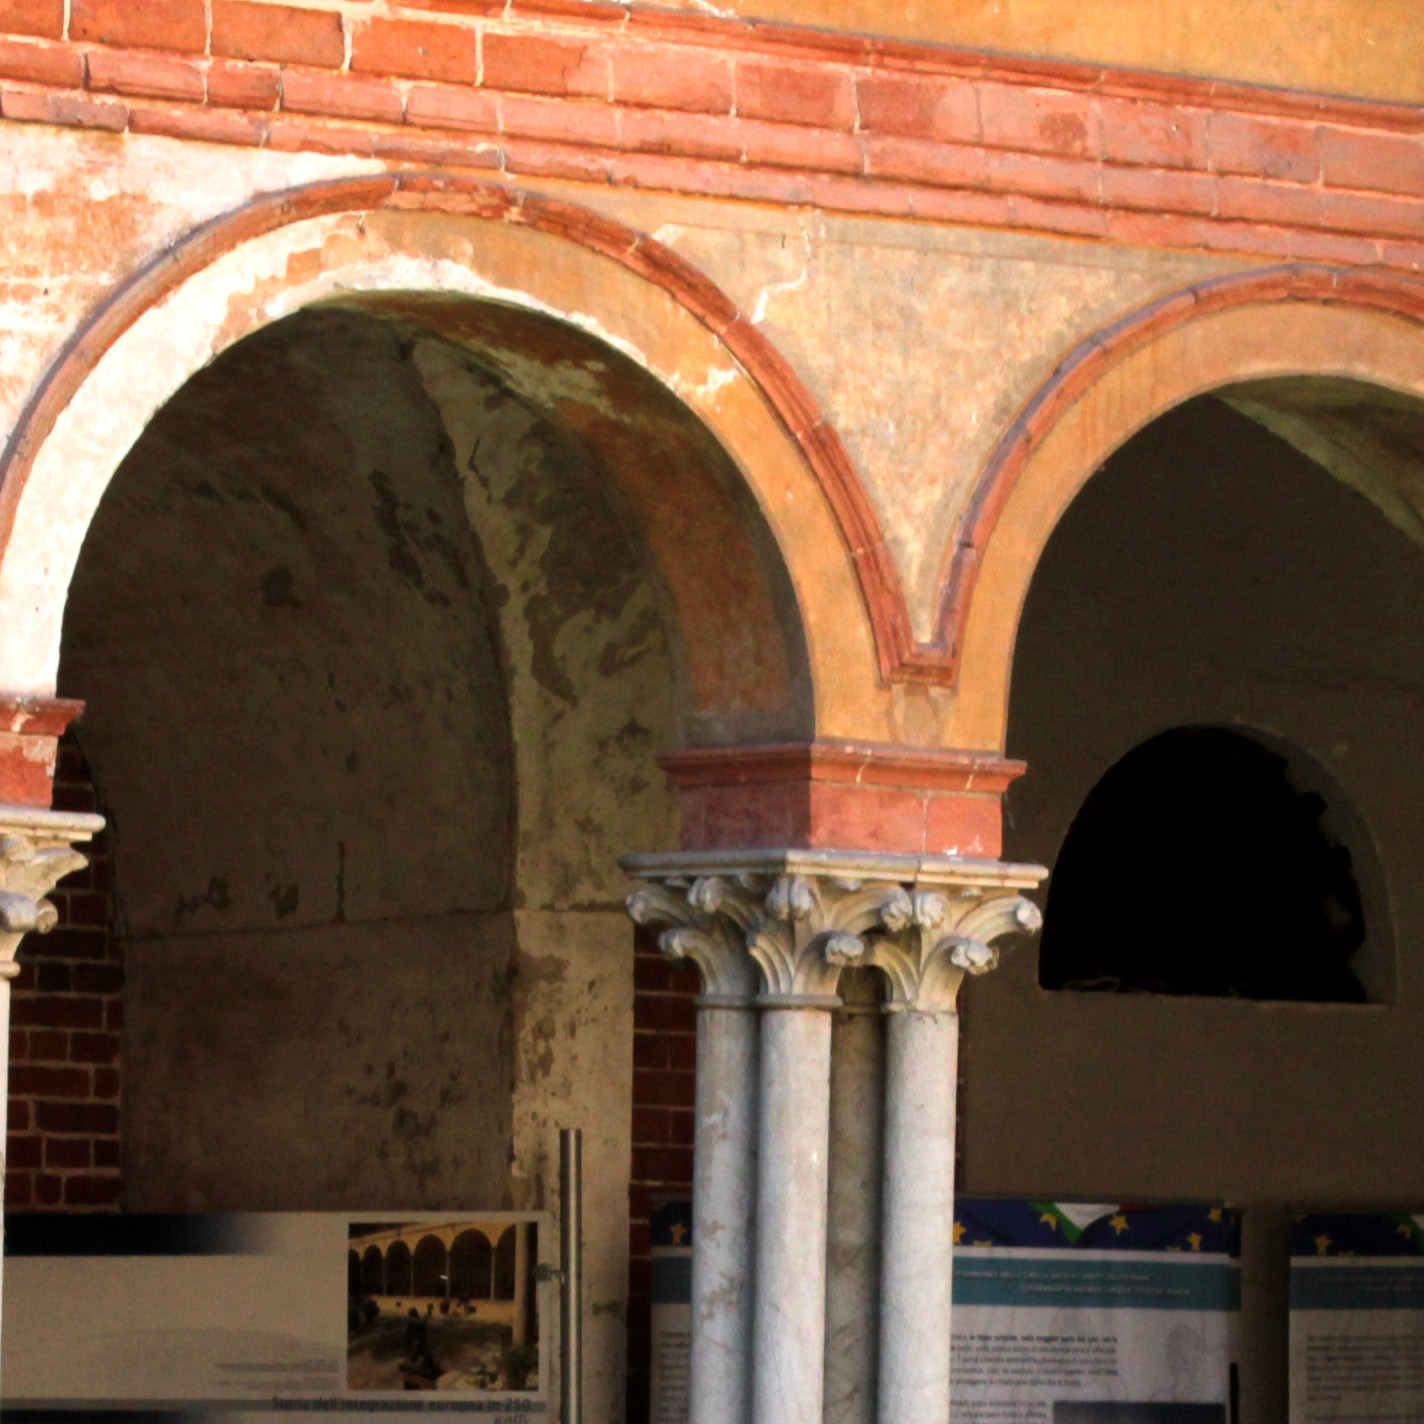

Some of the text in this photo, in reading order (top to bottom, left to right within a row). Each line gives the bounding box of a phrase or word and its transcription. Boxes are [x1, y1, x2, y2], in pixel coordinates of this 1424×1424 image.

[272, 1396, 532, 1413] Storia dell'integrazione europea in 250
